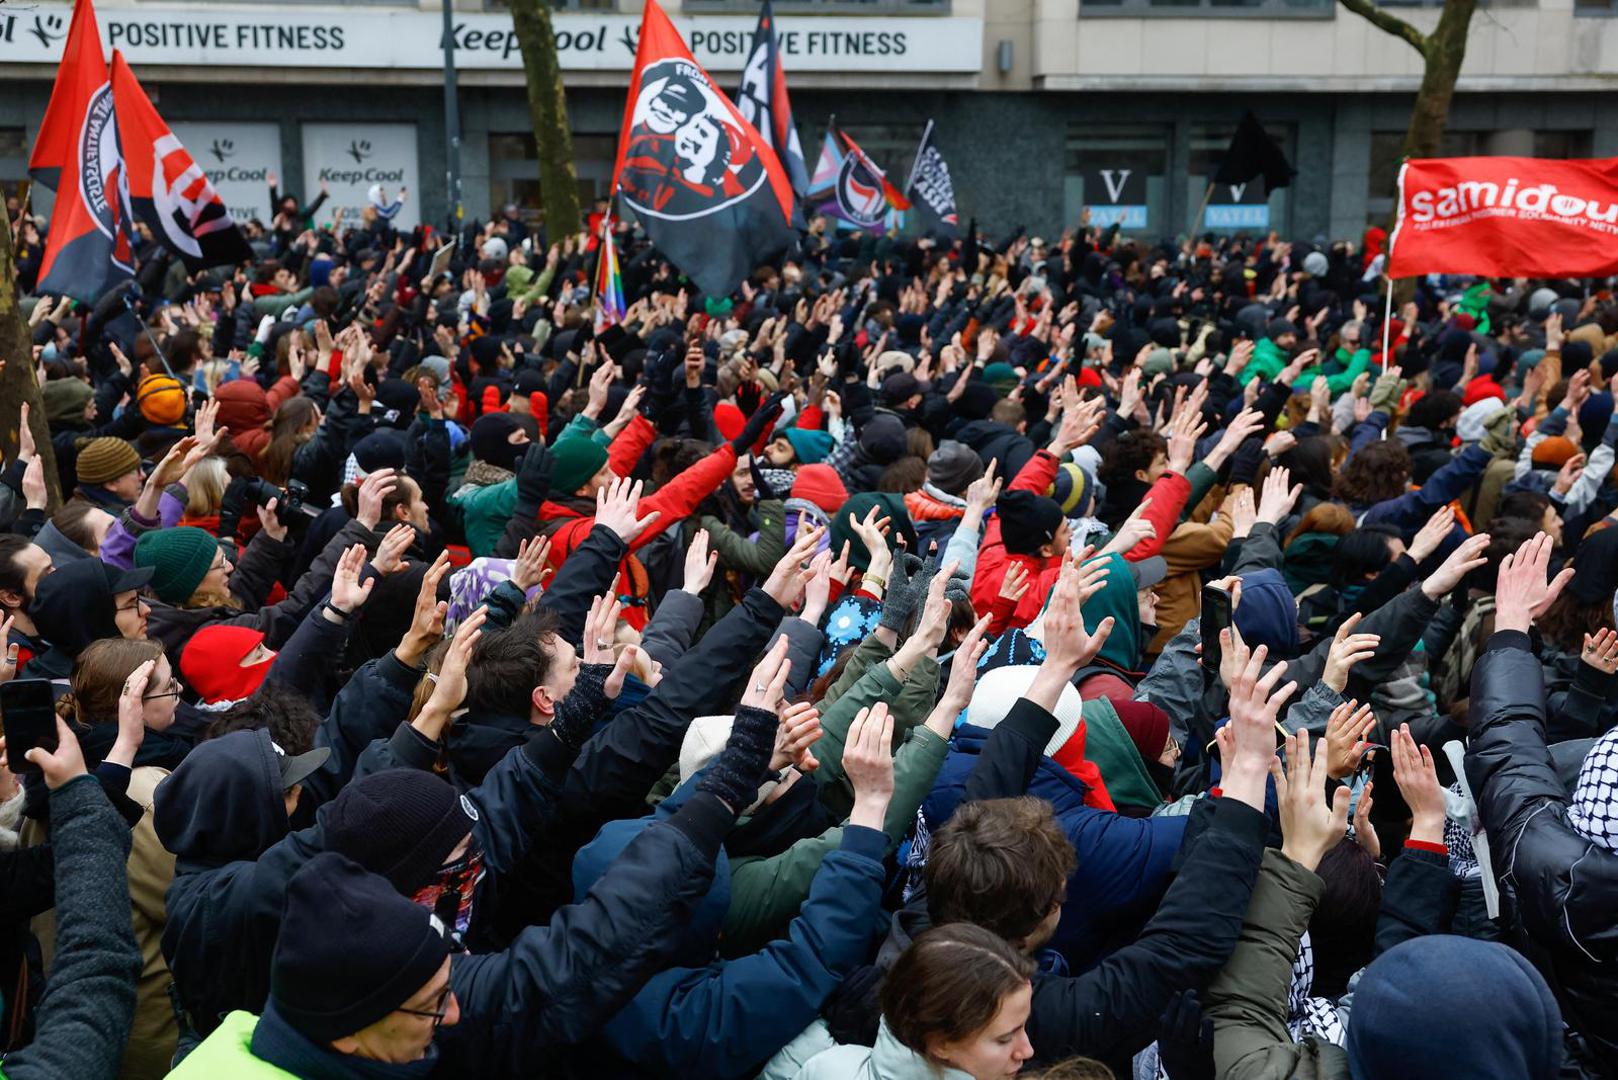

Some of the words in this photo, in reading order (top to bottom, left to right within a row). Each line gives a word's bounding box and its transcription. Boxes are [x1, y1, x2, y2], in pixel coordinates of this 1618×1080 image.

[108, 22, 228, 48] POSITIVE
[237, 24, 344, 50] FITNESS
[691, 31, 799, 55] POSITVE
[808, 32, 907, 55] FITNESS
[1100, 169, 1132, 204] V
